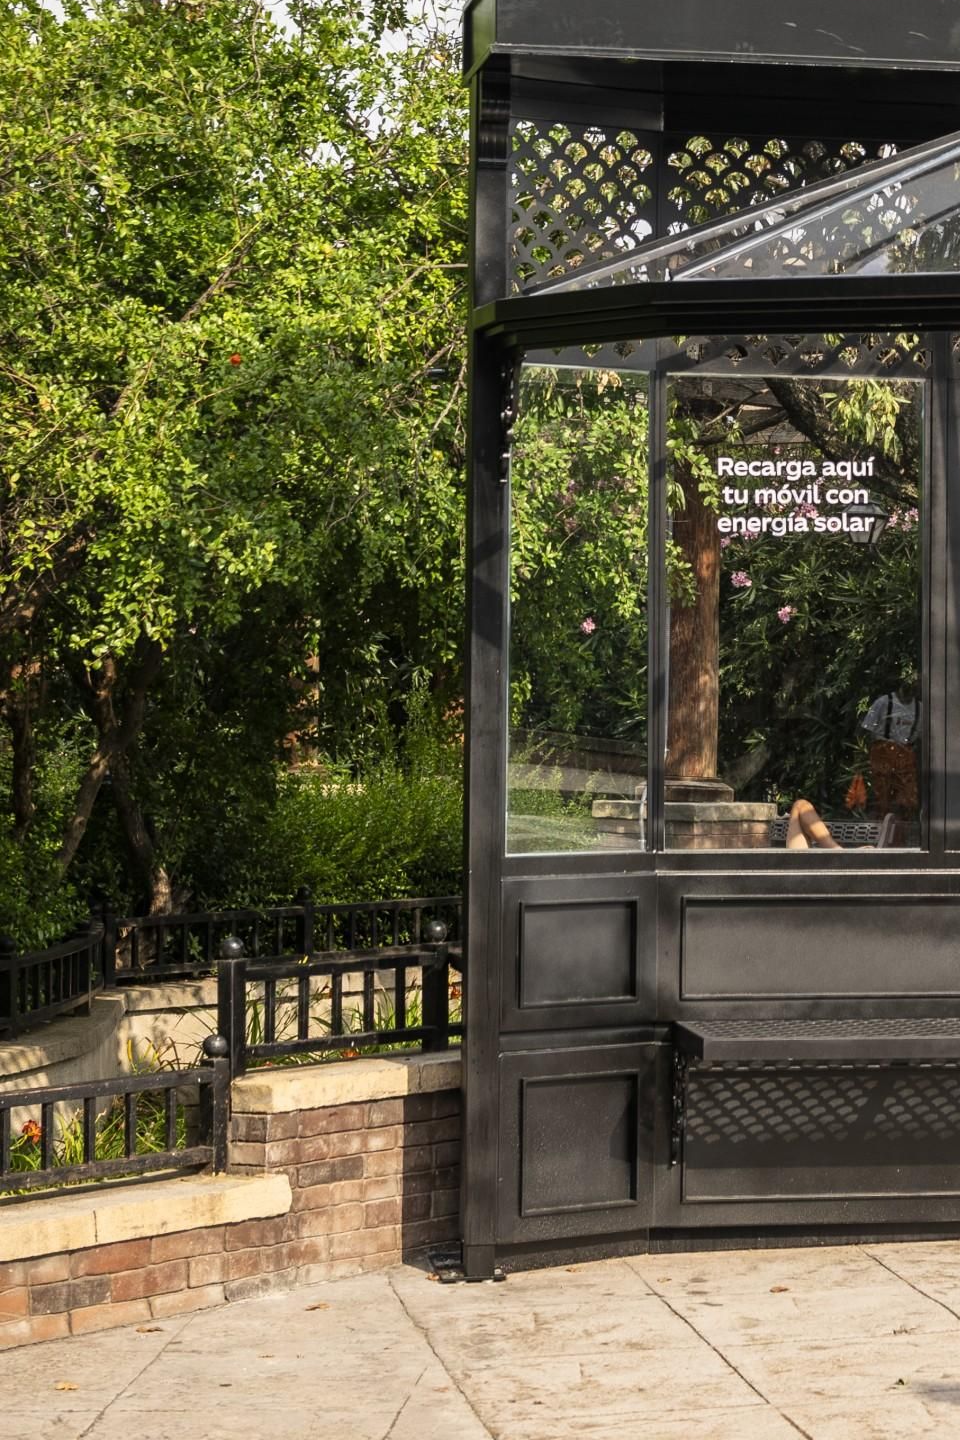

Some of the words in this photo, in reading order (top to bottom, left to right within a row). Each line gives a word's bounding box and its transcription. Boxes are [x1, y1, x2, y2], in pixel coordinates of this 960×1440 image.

[717, 457, 817, 481] Recarga
[822, 456, 875, 480] aquí
[723, 486, 748, 504] tu
[754, 484, 821, 504] móvil
[826, 488, 869, 504] con
[717, 512, 809, 536] energía
[814, 512, 875, 532] solar
